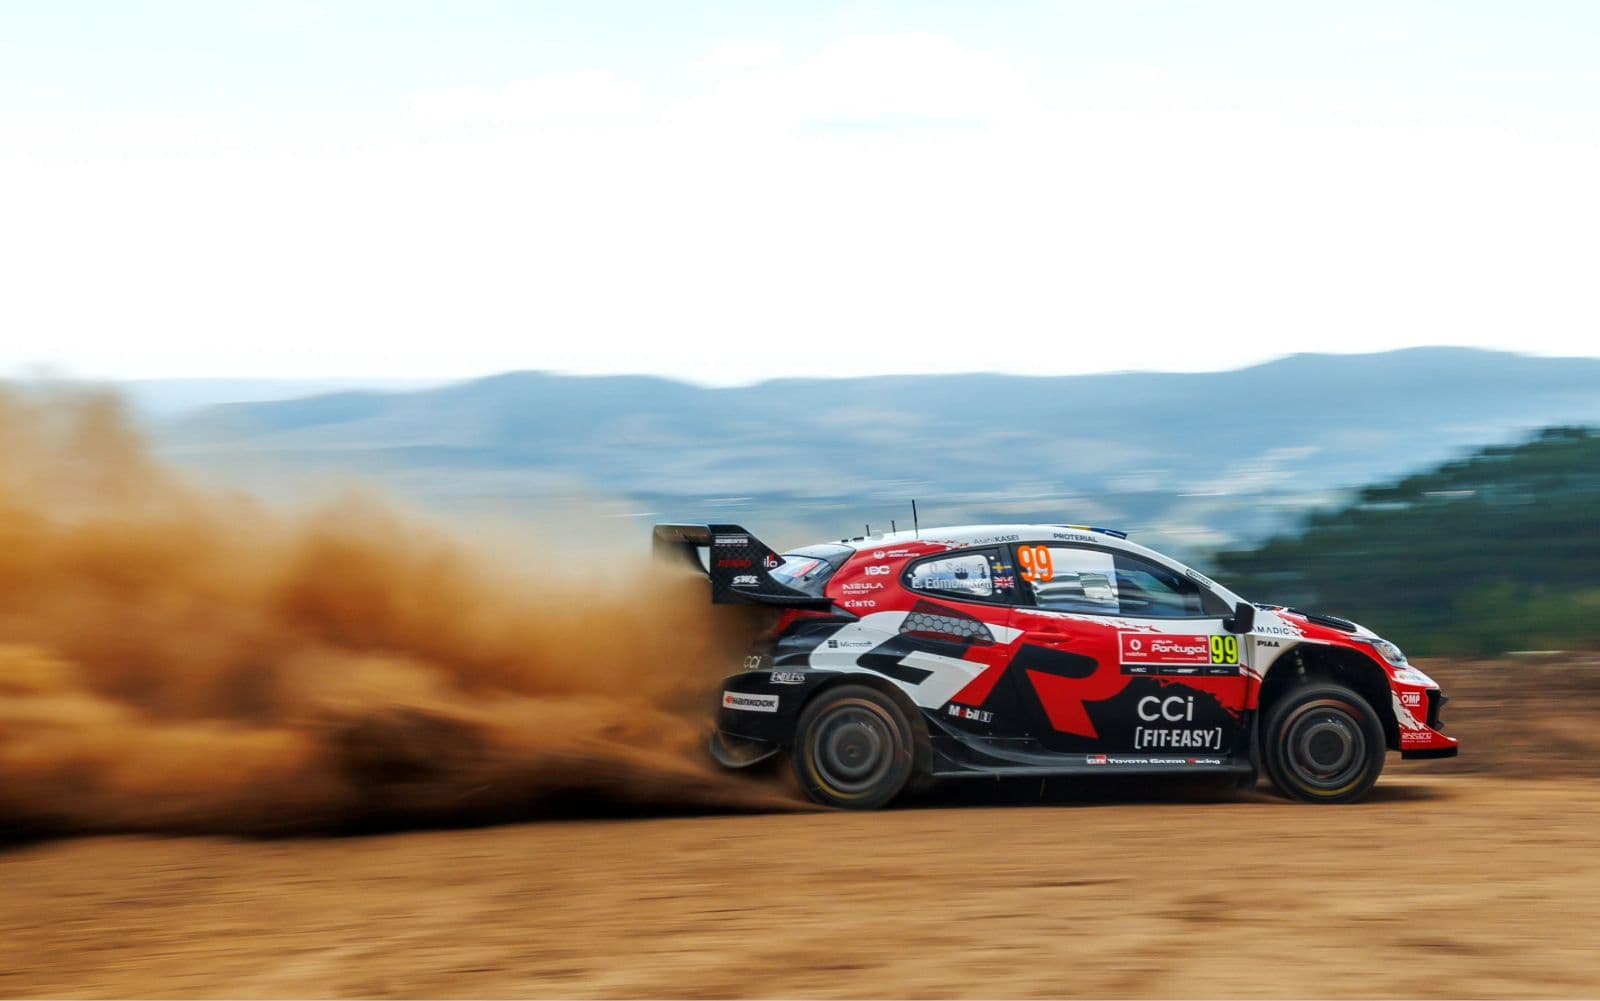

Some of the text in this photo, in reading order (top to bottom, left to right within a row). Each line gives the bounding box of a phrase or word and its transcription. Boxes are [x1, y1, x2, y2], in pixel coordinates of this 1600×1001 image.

[1053, 533, 1098, 542] PROTERIAL
[1017, 545, 1055, 583] 99
[1151, 643, 1208, 655] Portugal
[1211, 635, 1238, 664] 99
[1256, 640, 1280, 648] PIAA
[771, 672, 806, 682] ENDLESS
[1401, 694, 1420, 705] OMP
[949, 704, 980, 720] Mobil
